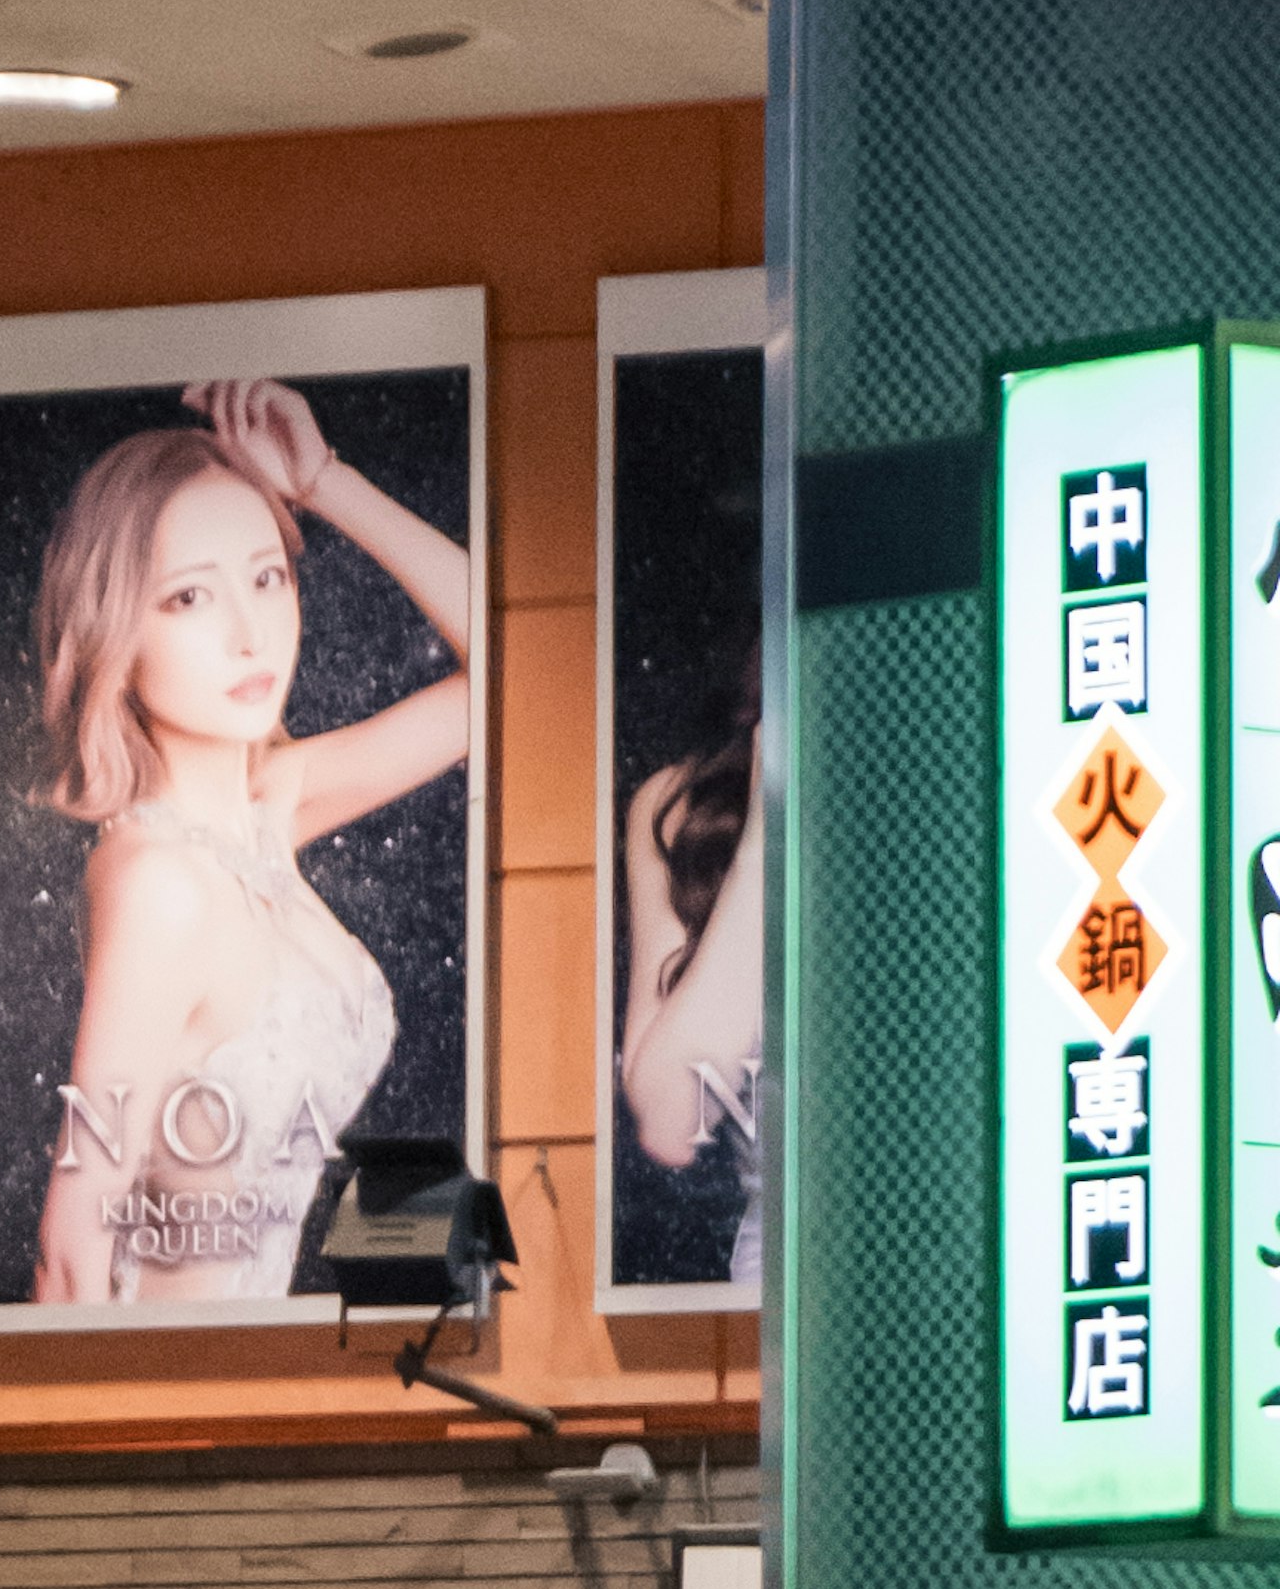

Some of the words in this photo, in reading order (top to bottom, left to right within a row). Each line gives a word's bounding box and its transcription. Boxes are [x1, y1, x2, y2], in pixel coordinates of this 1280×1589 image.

[1064, 468, 1149, 1417] 中国火鍋専門店
[56, 1077, 345, 1170] NOA
[100, 1190, 296, 1227] KINGDOM
[130, 1222, 262, 1265] QUEEN
